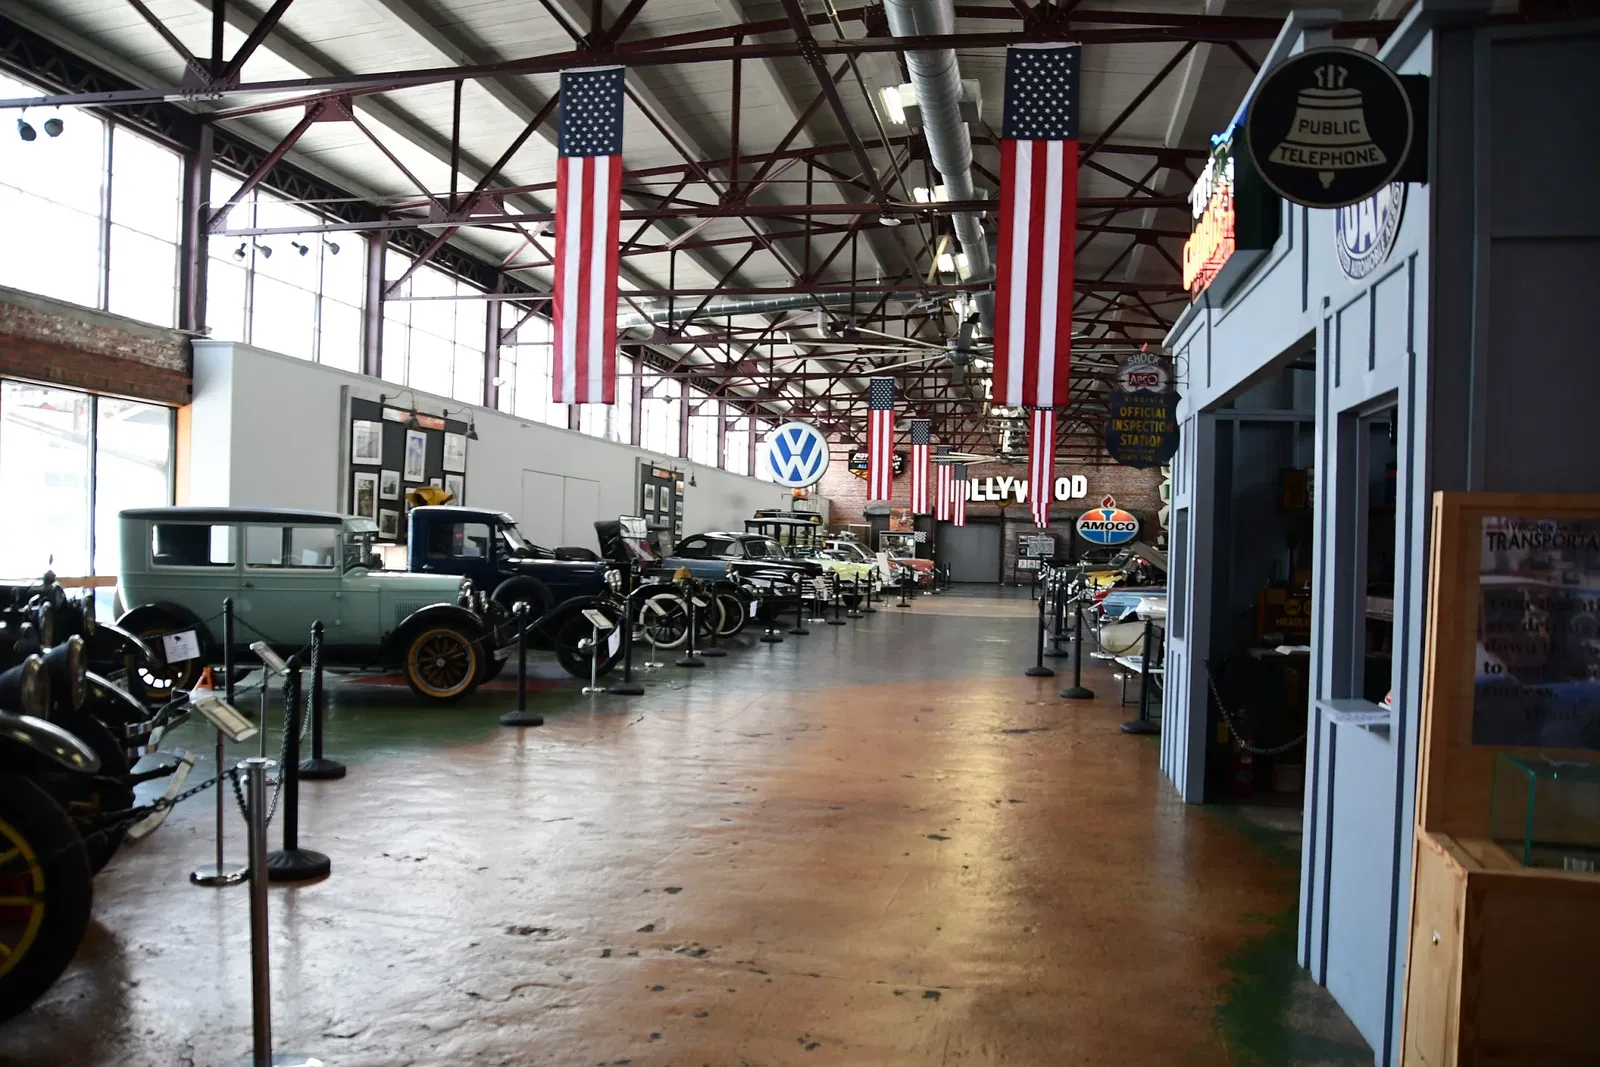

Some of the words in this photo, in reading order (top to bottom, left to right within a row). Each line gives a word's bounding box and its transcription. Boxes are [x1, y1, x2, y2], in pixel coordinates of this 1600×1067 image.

[1298, 119, 1361, 135] PUBLIC
[1279, 146, 1380, 166] TELEPHONE
[1127, 352, 1161, 366] SHOCK
[1119, 406, 1168, 419] OFFICIAL
[1112, 419, 1174, 433] INSPECTION
[1120, 434, 1165, 448] STATION
[950, 475, 1088, 503] LLYWOD
[1079, 521, 1136, 532] AMOCO
[1485, 531, 1598, 551] TRANSPORTA
